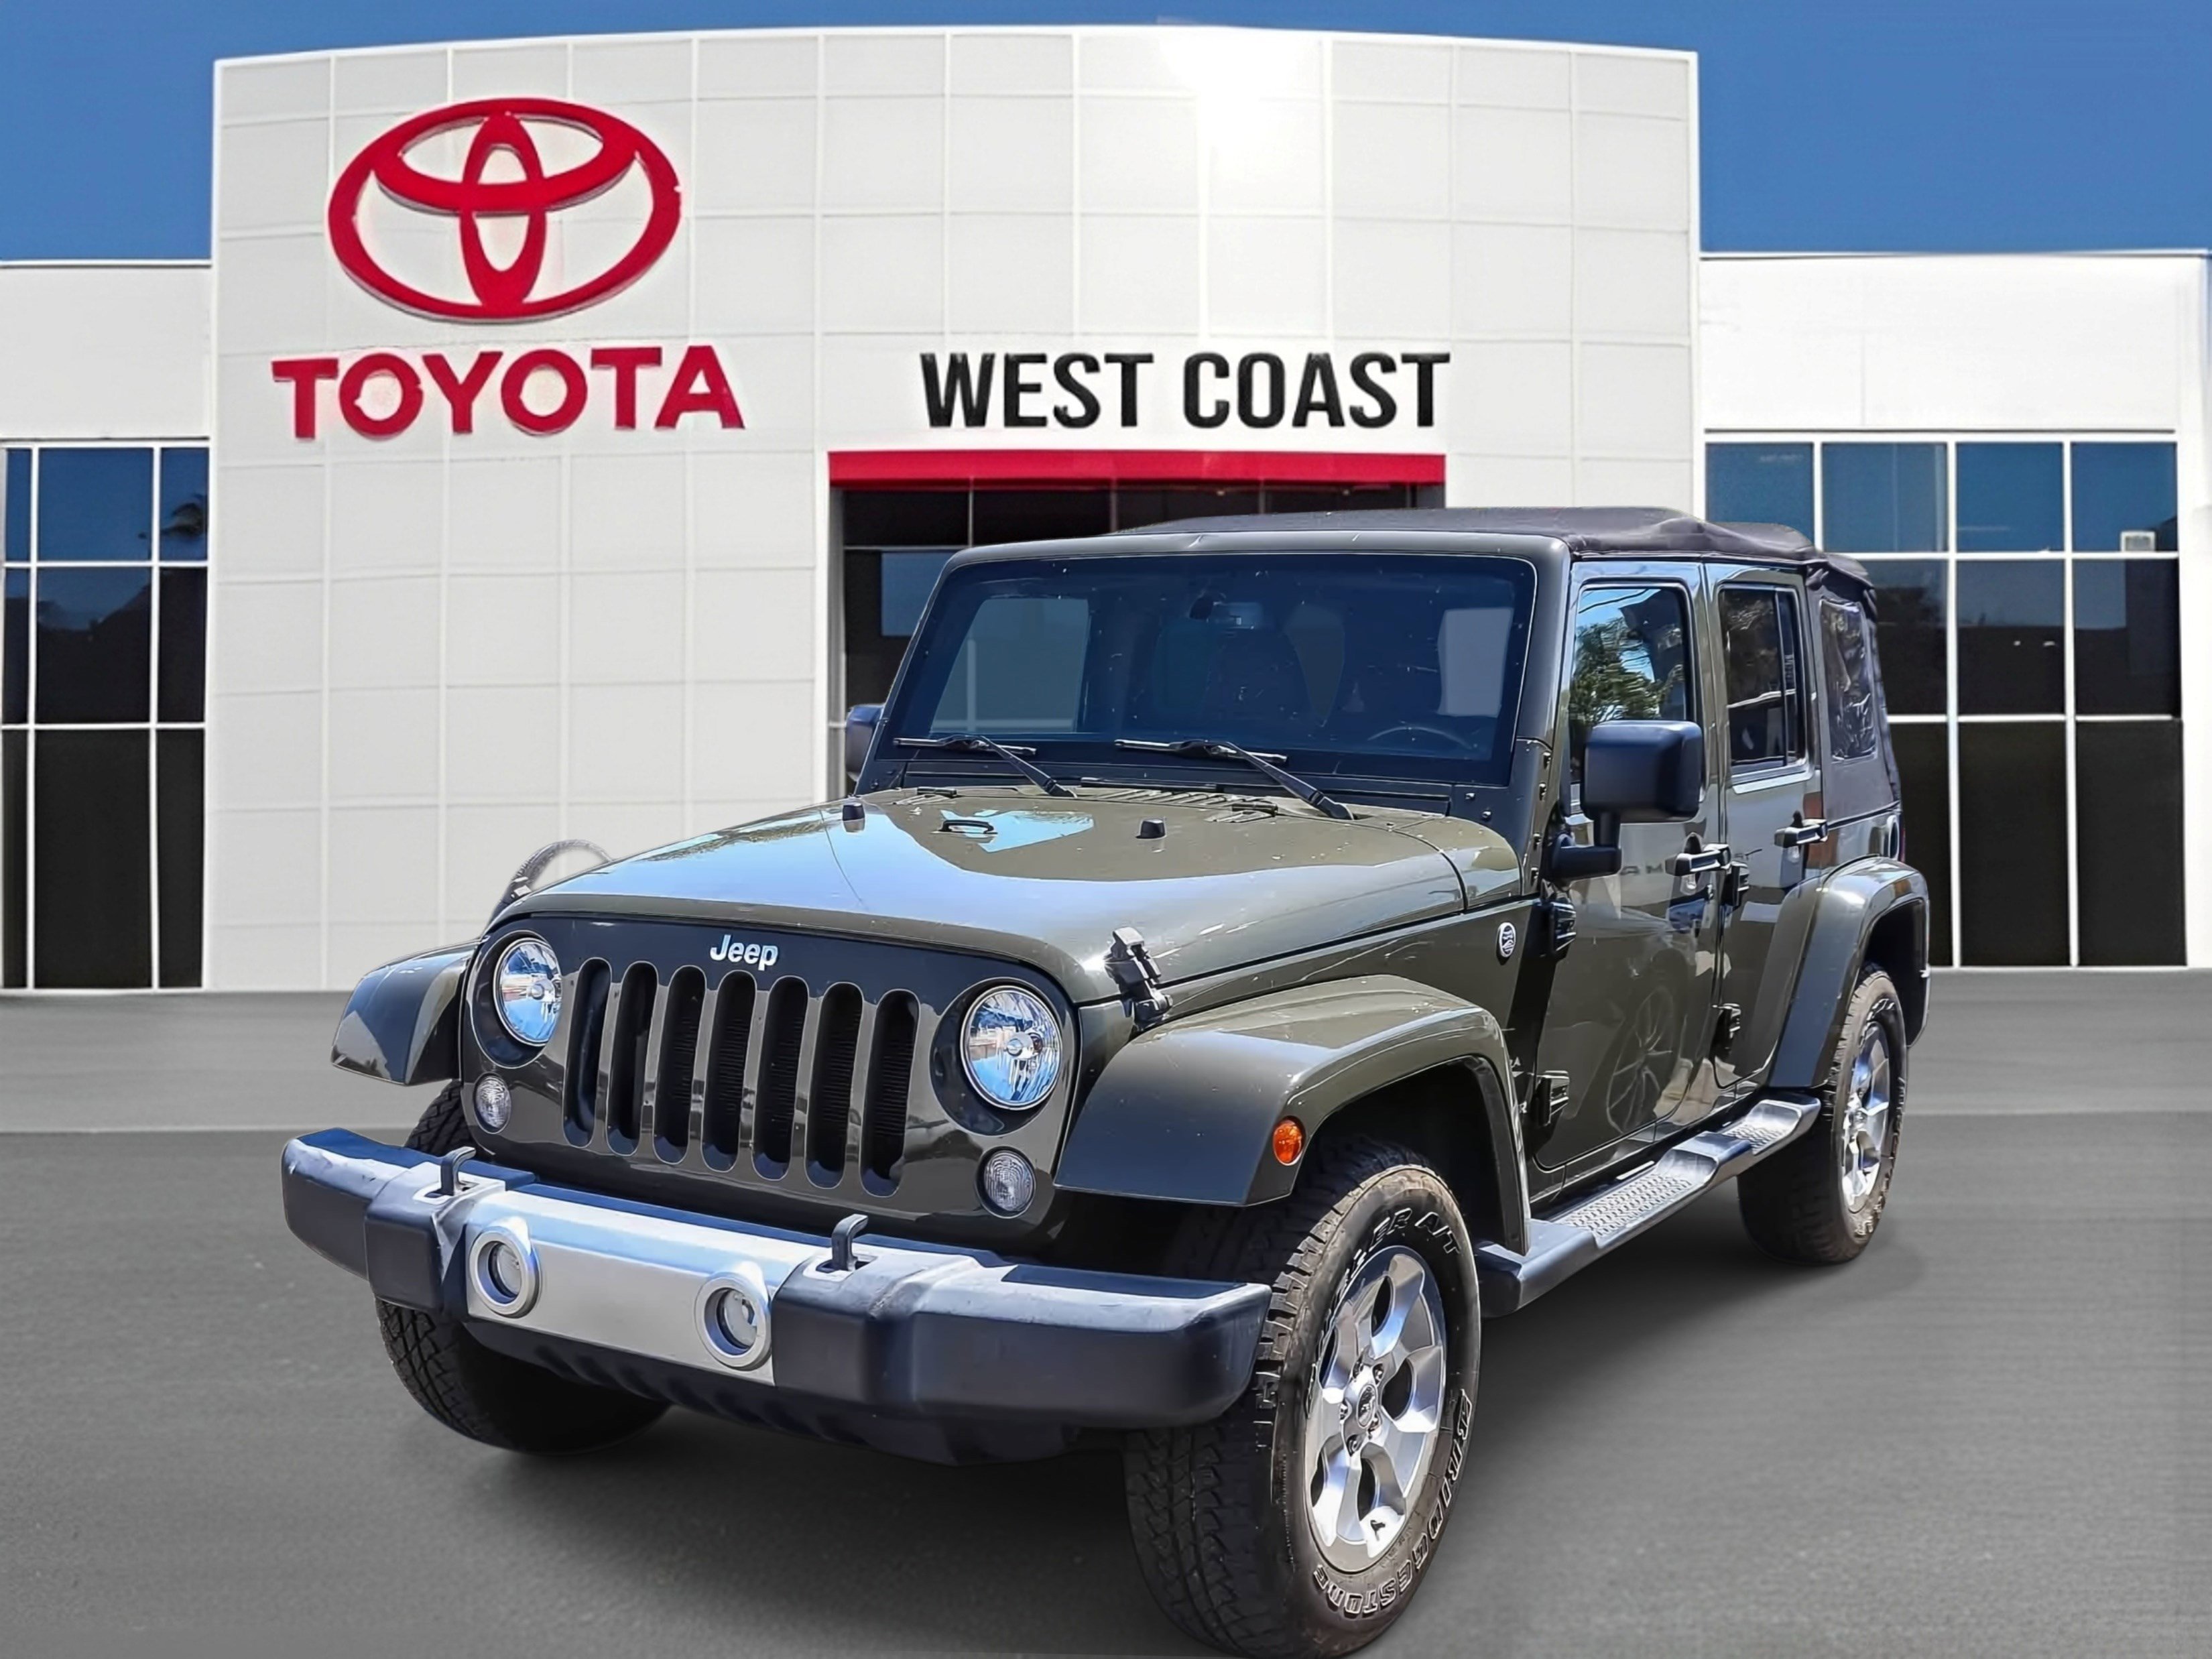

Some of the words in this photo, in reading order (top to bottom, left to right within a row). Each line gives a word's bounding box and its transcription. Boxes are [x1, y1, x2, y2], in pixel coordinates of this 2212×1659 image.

[271, 345, 745, 440] TOYOTA
[920, 353, 1154, 428] WEST
[1183, 353, 1451, 428] COAST
[710, 934, 778, 971] Jeep
[1313, 1389, 1473, 1615] BRIDGESTONE
